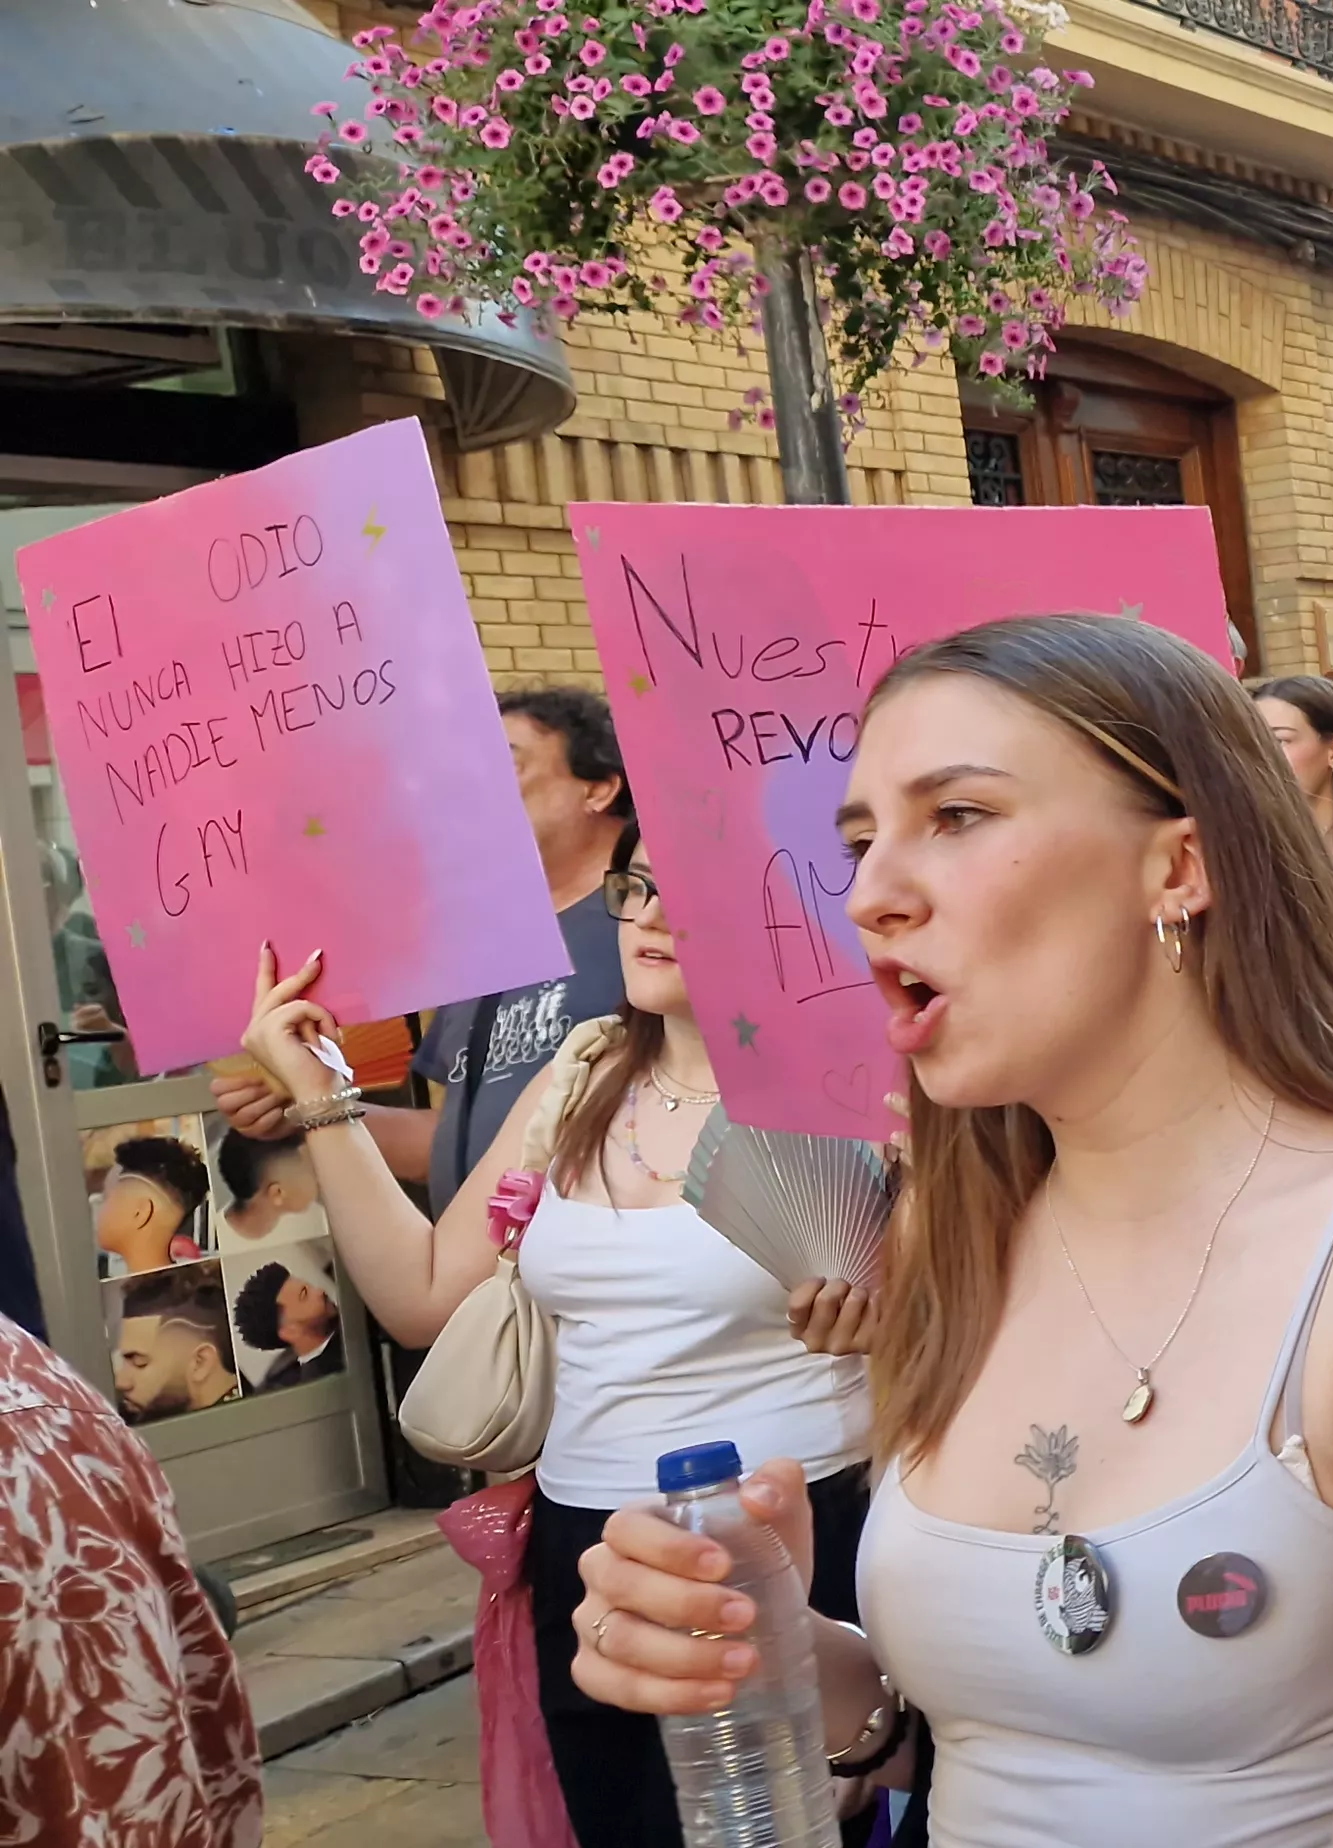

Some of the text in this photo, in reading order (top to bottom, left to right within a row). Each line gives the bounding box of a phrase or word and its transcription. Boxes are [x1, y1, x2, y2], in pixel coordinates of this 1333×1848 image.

[207, 514, 323, 602] ODIO
[77, 600, 363, 750] NUNCA HIZO A
[620, 553, 916, 687] Nuestr
[106, 659, 396, 824] NADIE MENOS
[711, 708, 858, 770] REVO
[156, 810, 249, 917] GAY
